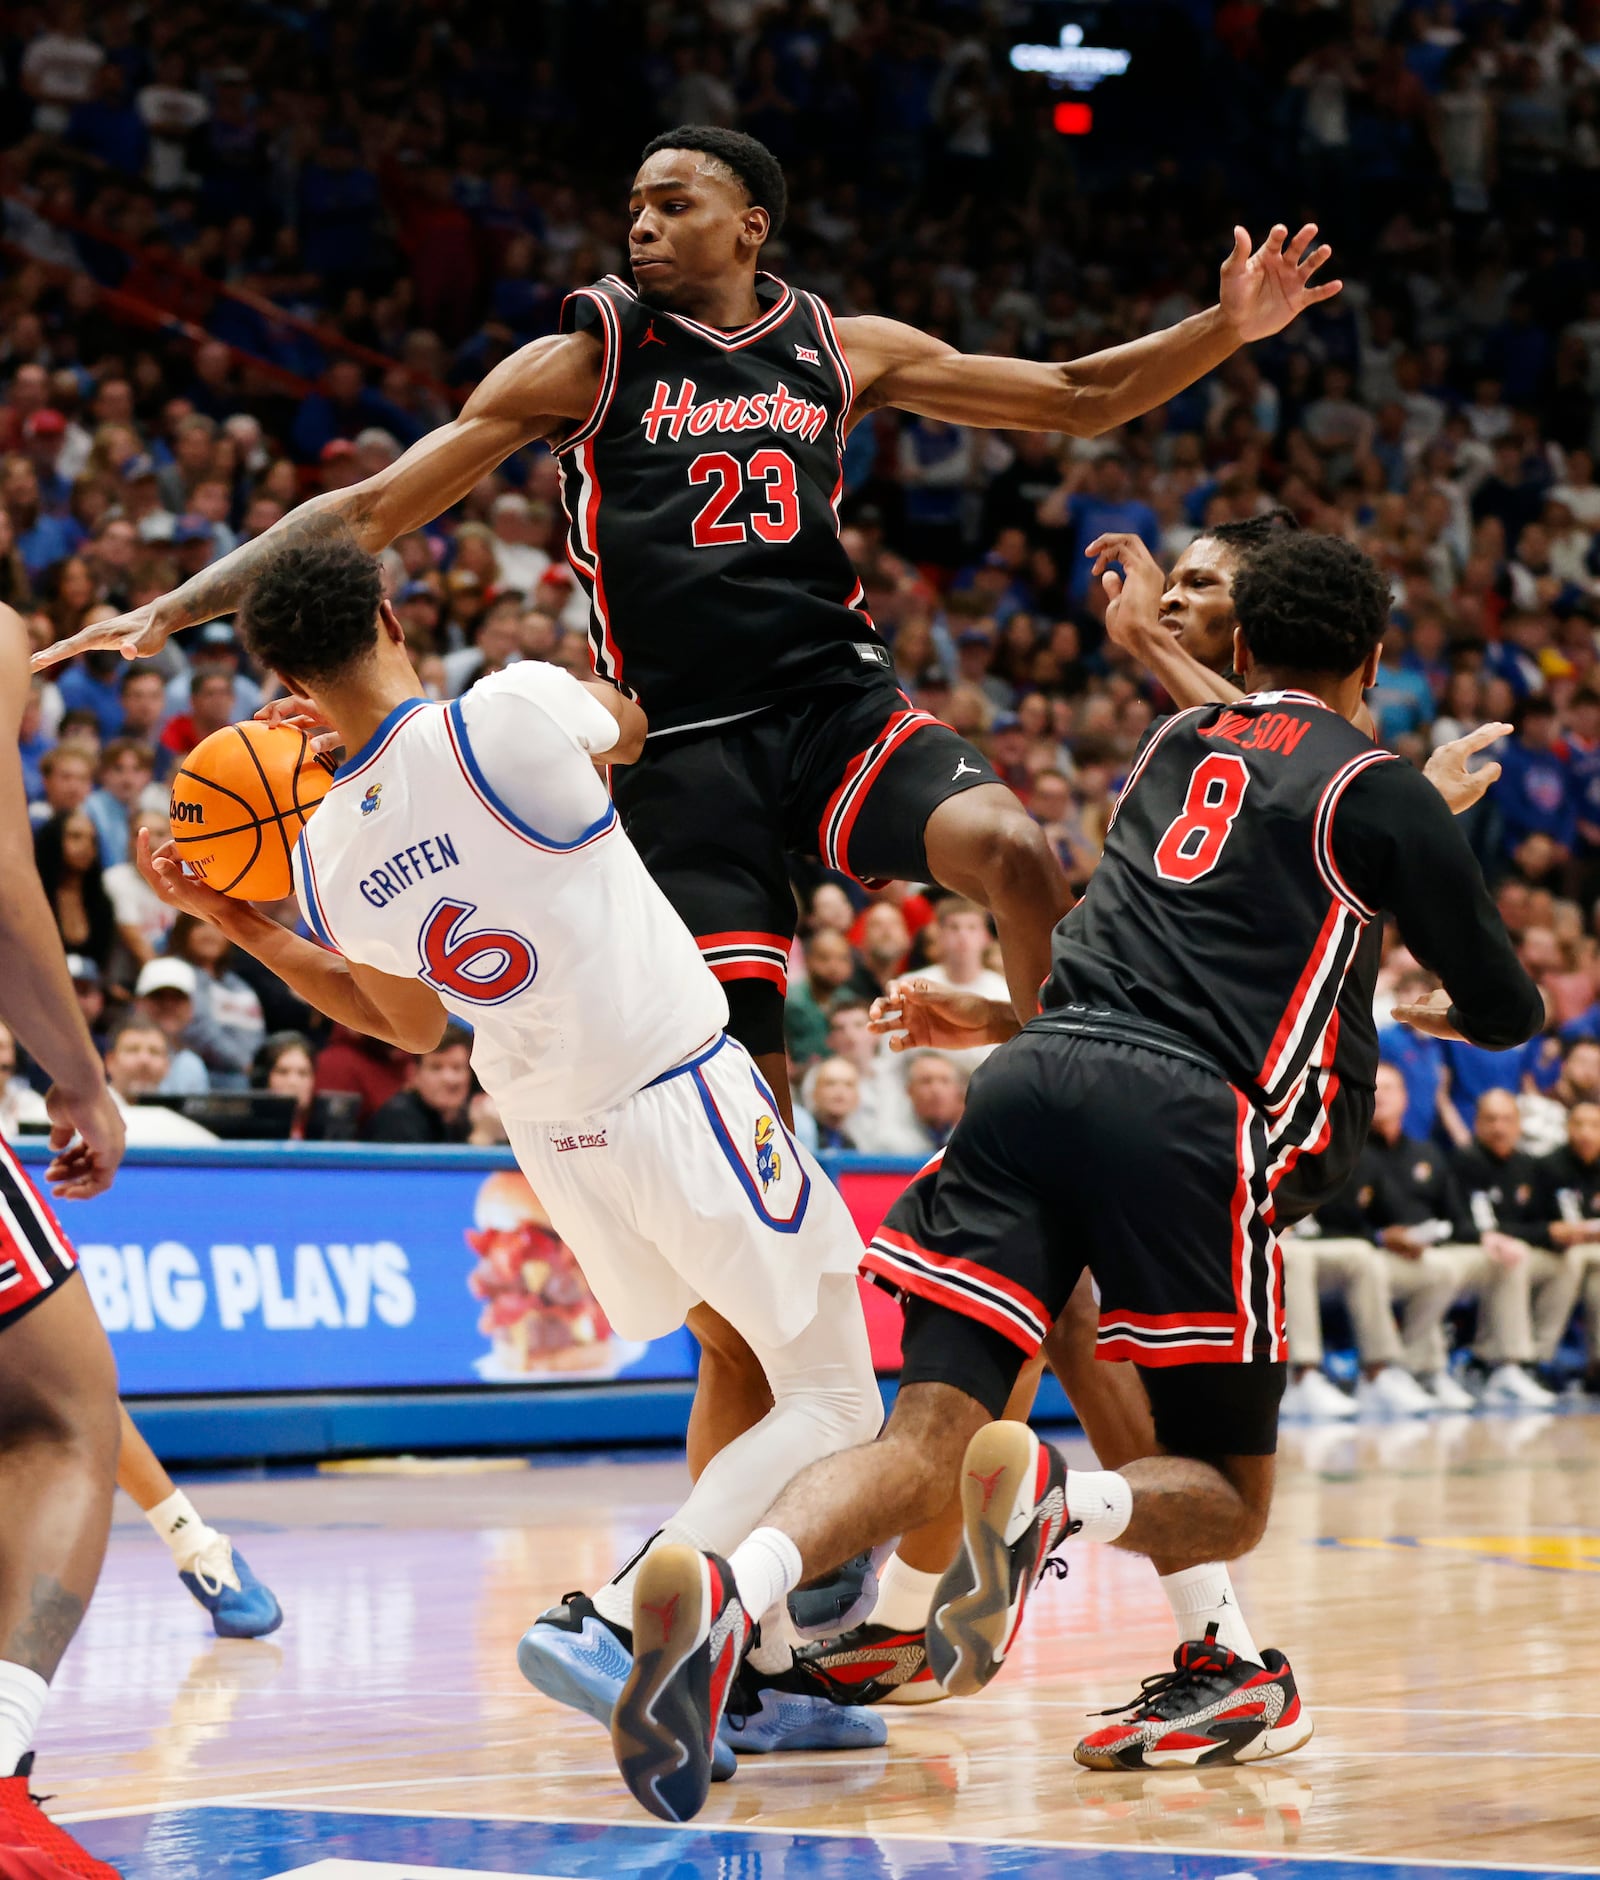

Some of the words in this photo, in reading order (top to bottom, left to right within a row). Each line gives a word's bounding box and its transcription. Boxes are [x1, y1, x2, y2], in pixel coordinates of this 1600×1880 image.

[641, 377, 828, 444] Houston
[688, 449, 800, 547] 23
[170, 788, 204, 824] lson
[1154, 752, 1251, 884] 8
[359, 833, 460, 908] GRIFFEN
[418, 897, 538, 1006] 6
[78, 1242, 207, 1332] BIG
[210, 1242, 416, 1331] PLAYS
